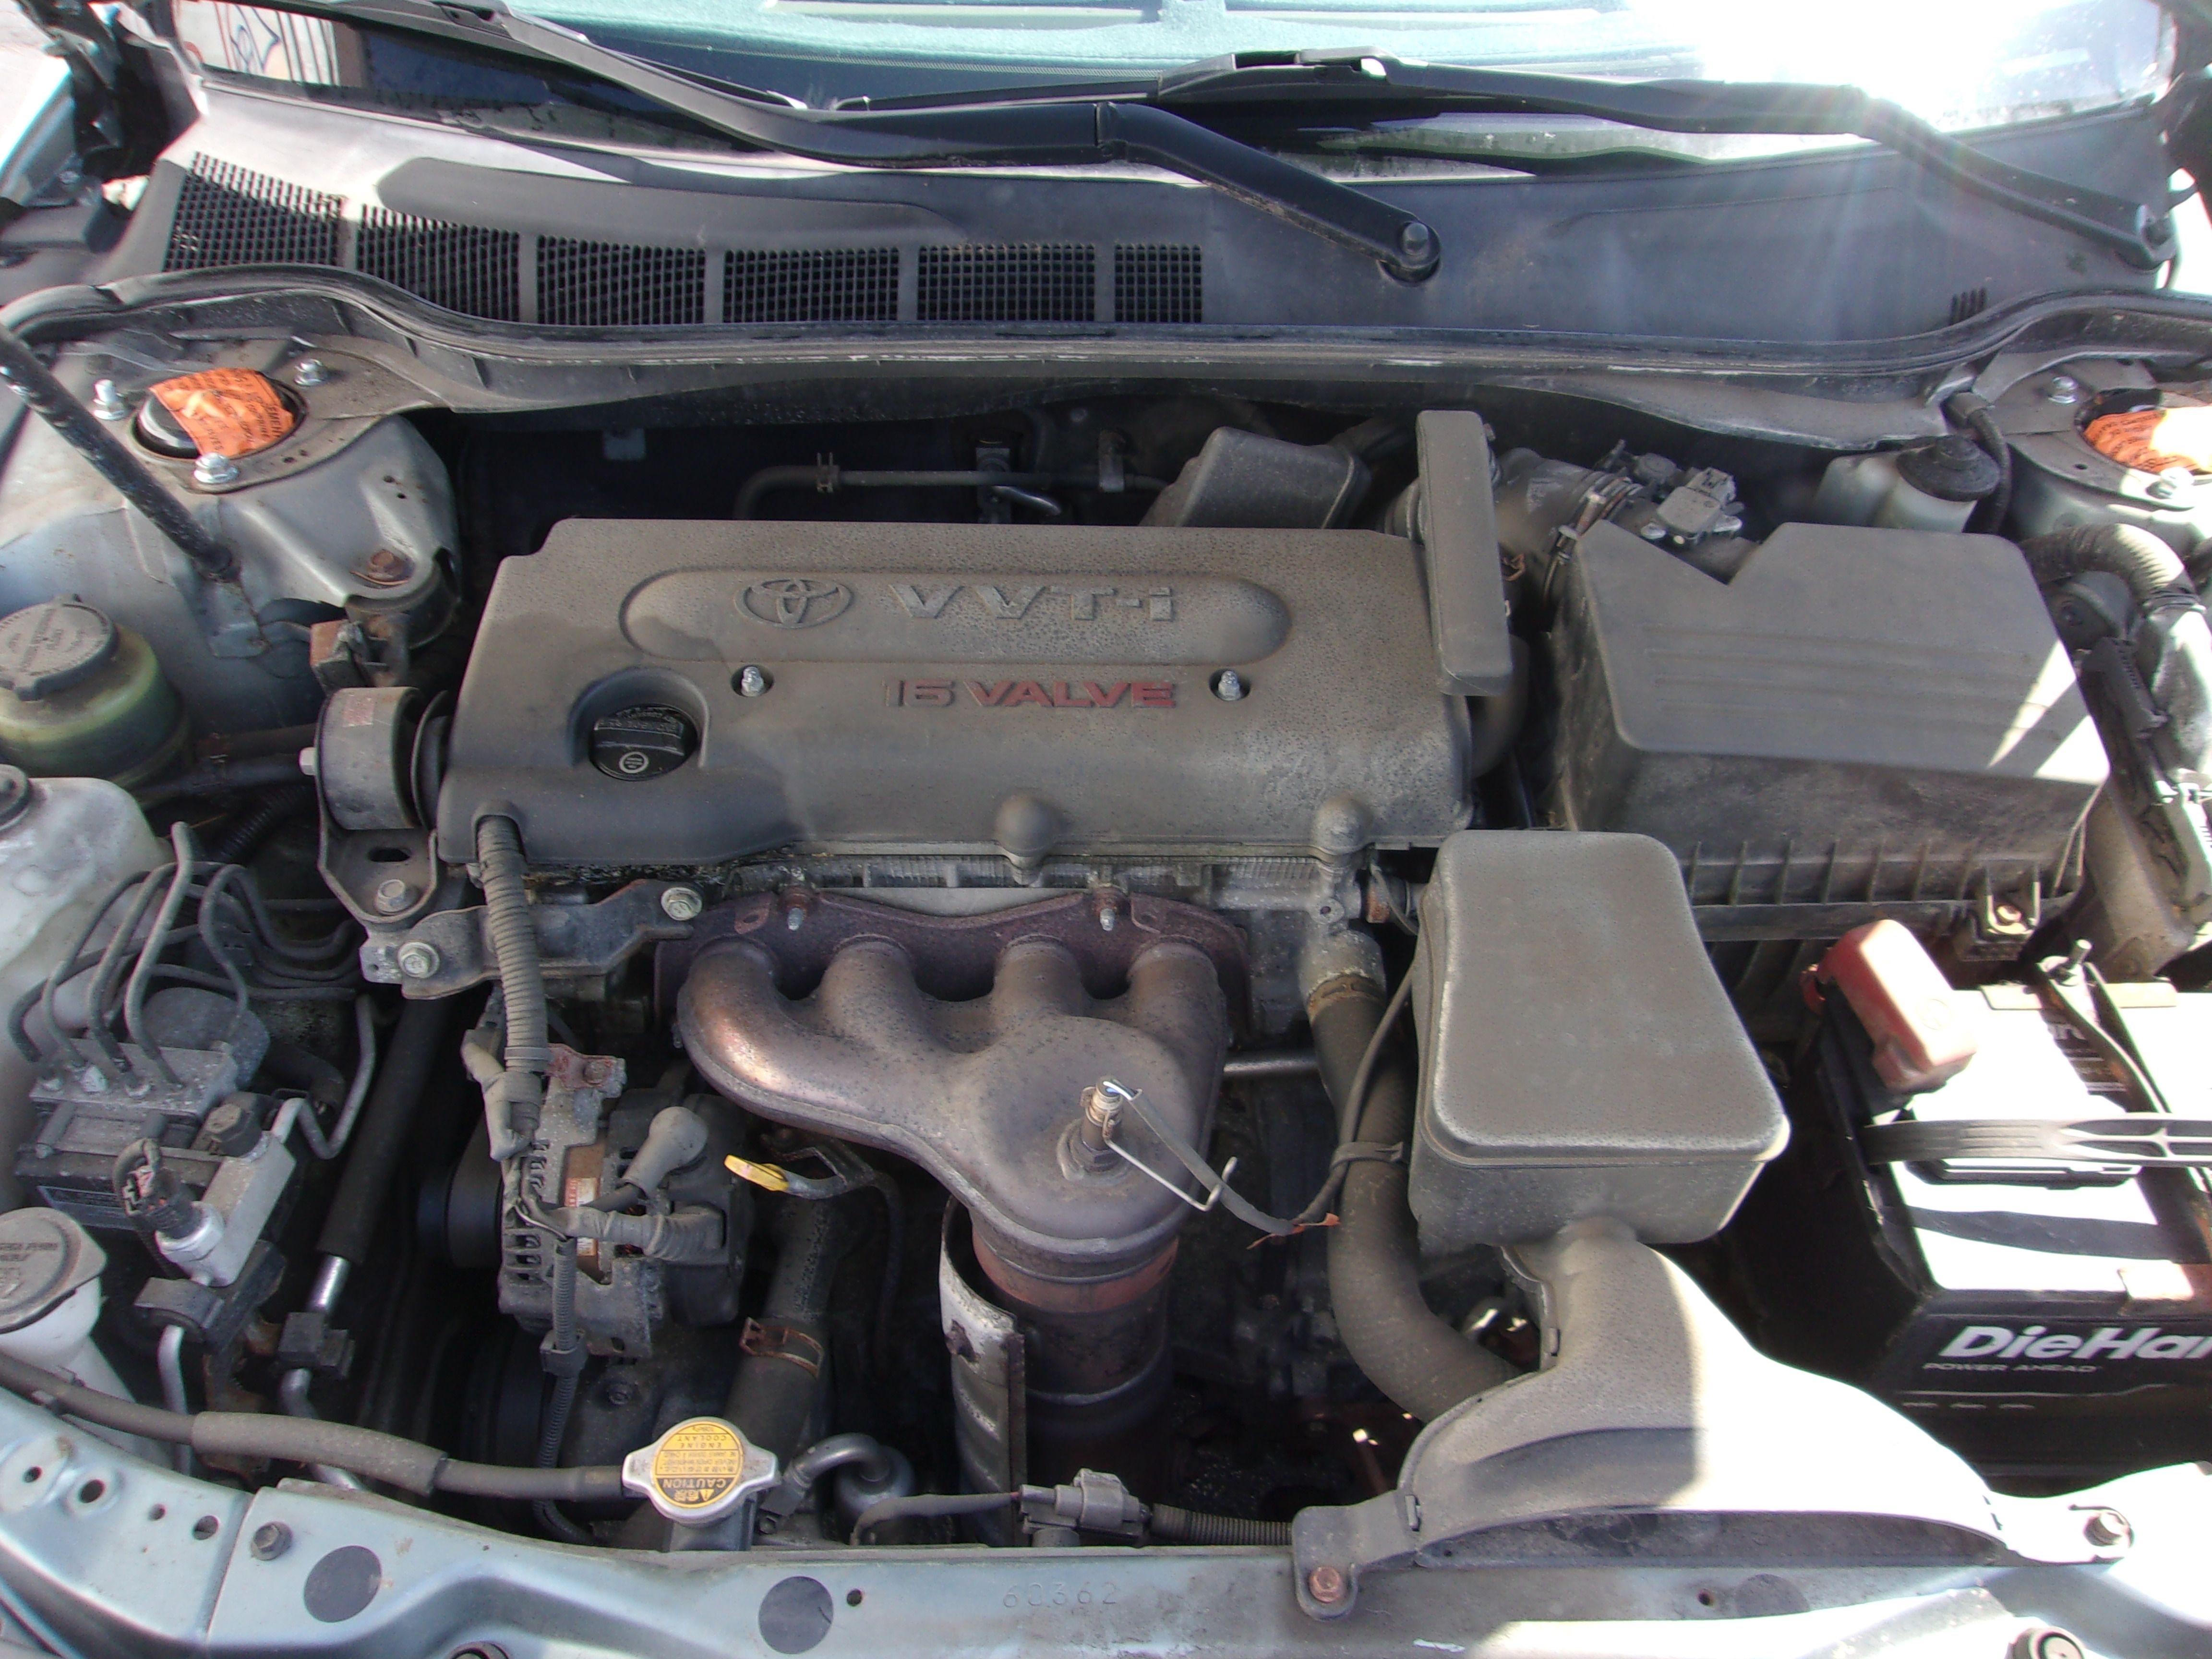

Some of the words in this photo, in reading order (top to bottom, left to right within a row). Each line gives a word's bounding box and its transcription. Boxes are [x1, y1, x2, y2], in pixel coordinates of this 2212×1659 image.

[889, 585, 1175, 622] VVT-i
[881, 679, 956, 707] 16
[962, 680, 1177, 708] VALVE
[1923, 1363, 2008, 1371] POWER
[2011, 1363, 2097, 1372] AHEAD
[662, 1479, 726, 1489] CAUTION
[1003, 1582, 1117, 1608] 60362
